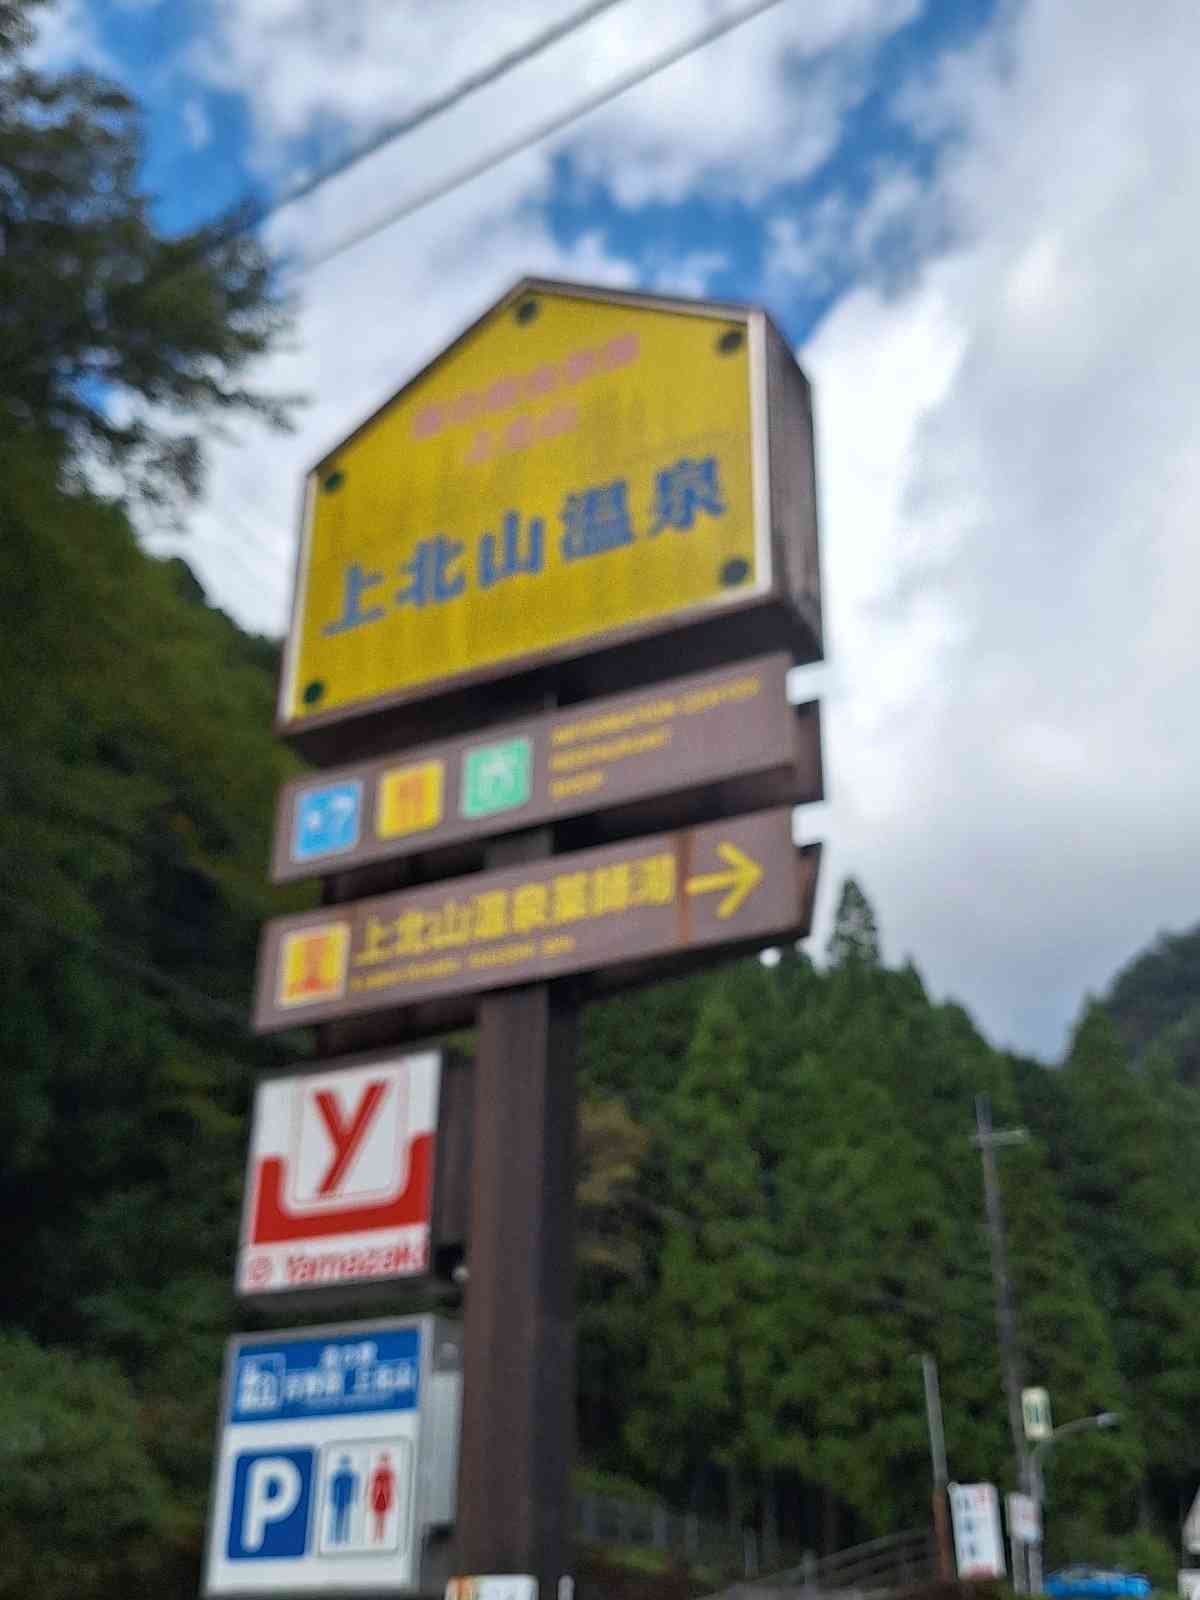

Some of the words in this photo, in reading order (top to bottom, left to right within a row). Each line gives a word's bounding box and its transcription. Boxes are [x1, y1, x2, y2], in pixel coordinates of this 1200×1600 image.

[320, 454, 727, 637] 上北山温泉
[241, 1455, 301, 1553] P
